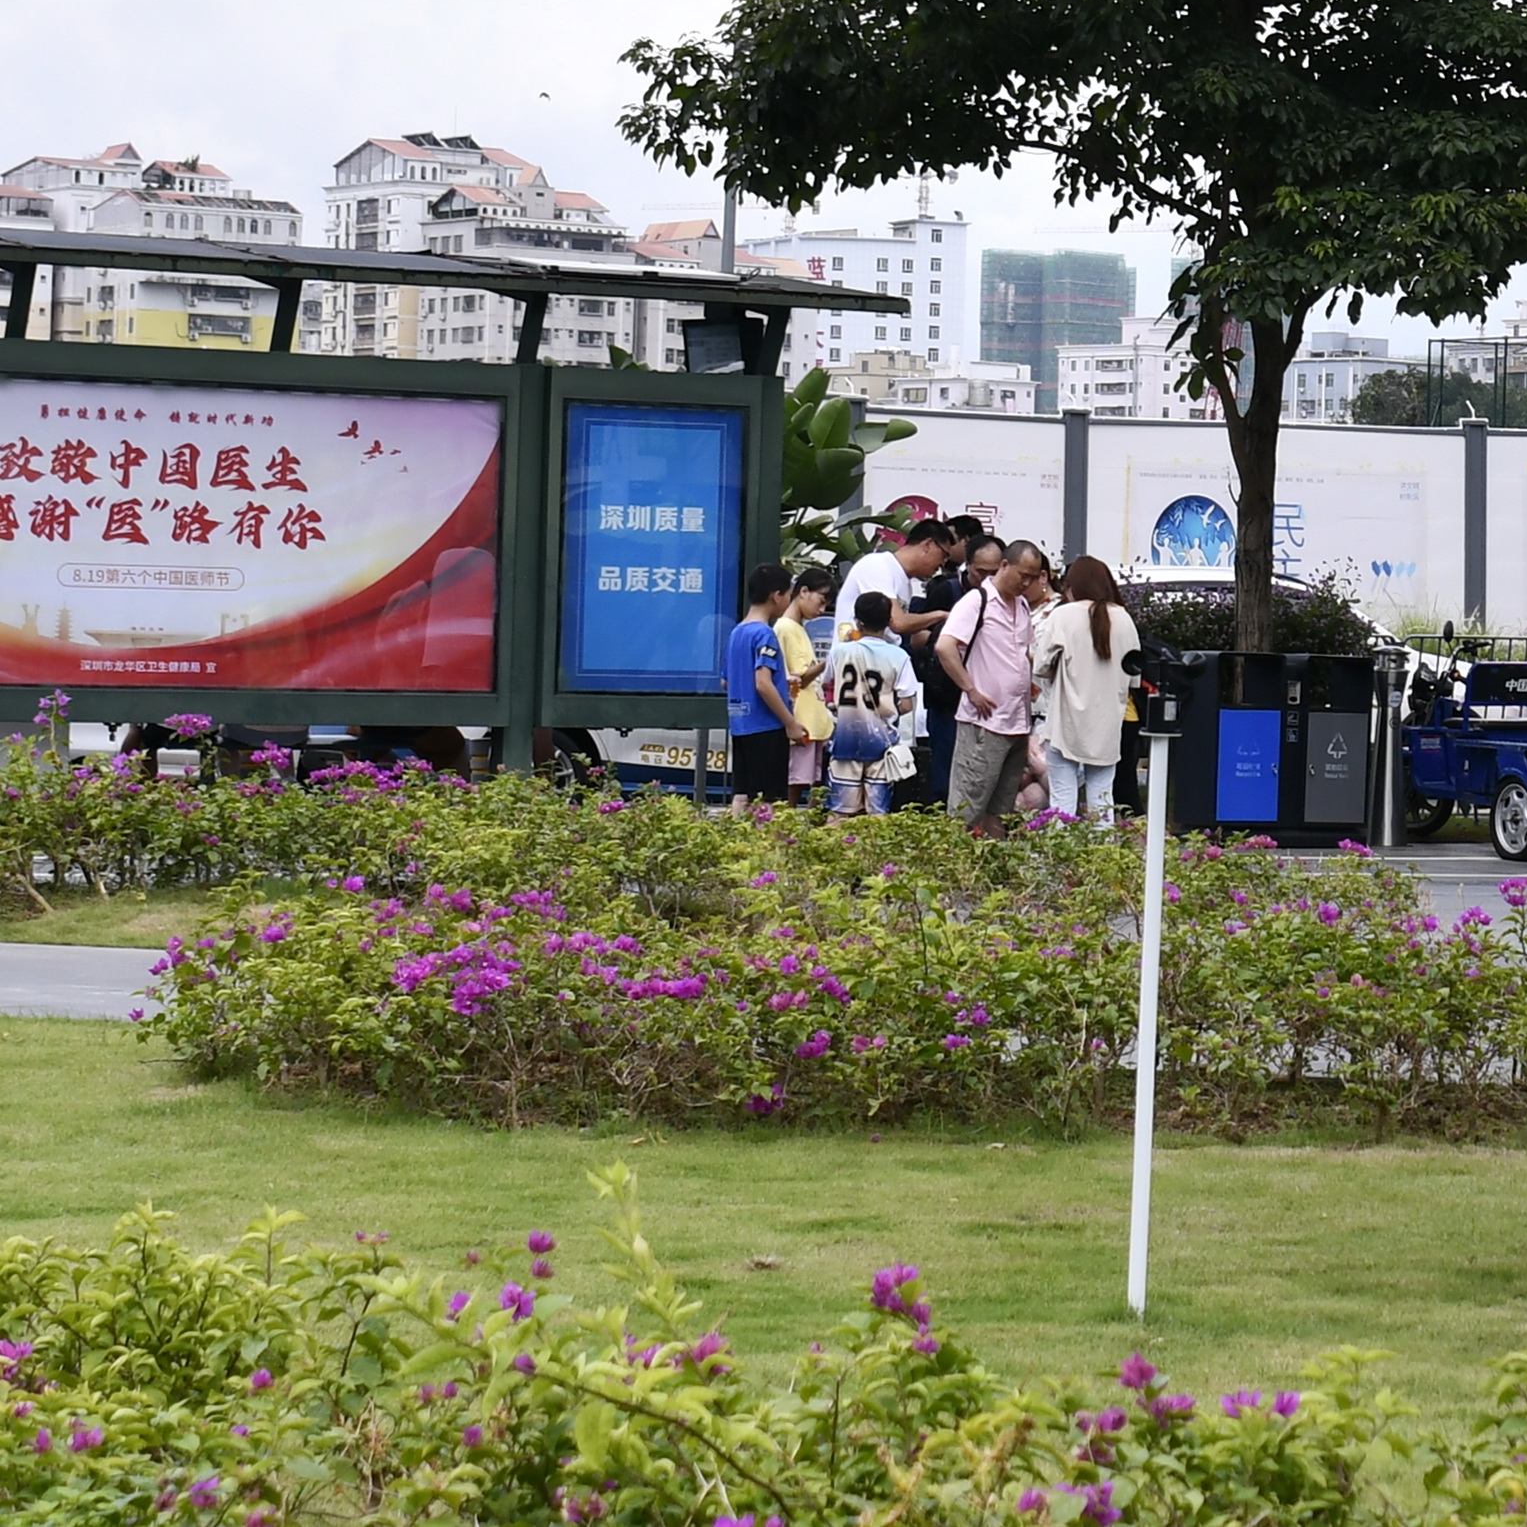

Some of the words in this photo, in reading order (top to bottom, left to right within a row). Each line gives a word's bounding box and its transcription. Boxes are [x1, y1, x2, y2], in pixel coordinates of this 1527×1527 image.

[0, 435, 308, 492] 致敬中国医生
[600, 504, 706, 533] 深圳质量
[72, 567, 231, 588] 8.19第六个中国医师节
[598, 566, 704, 594] 品质交通
[667, 746, 726, 770] 9528
